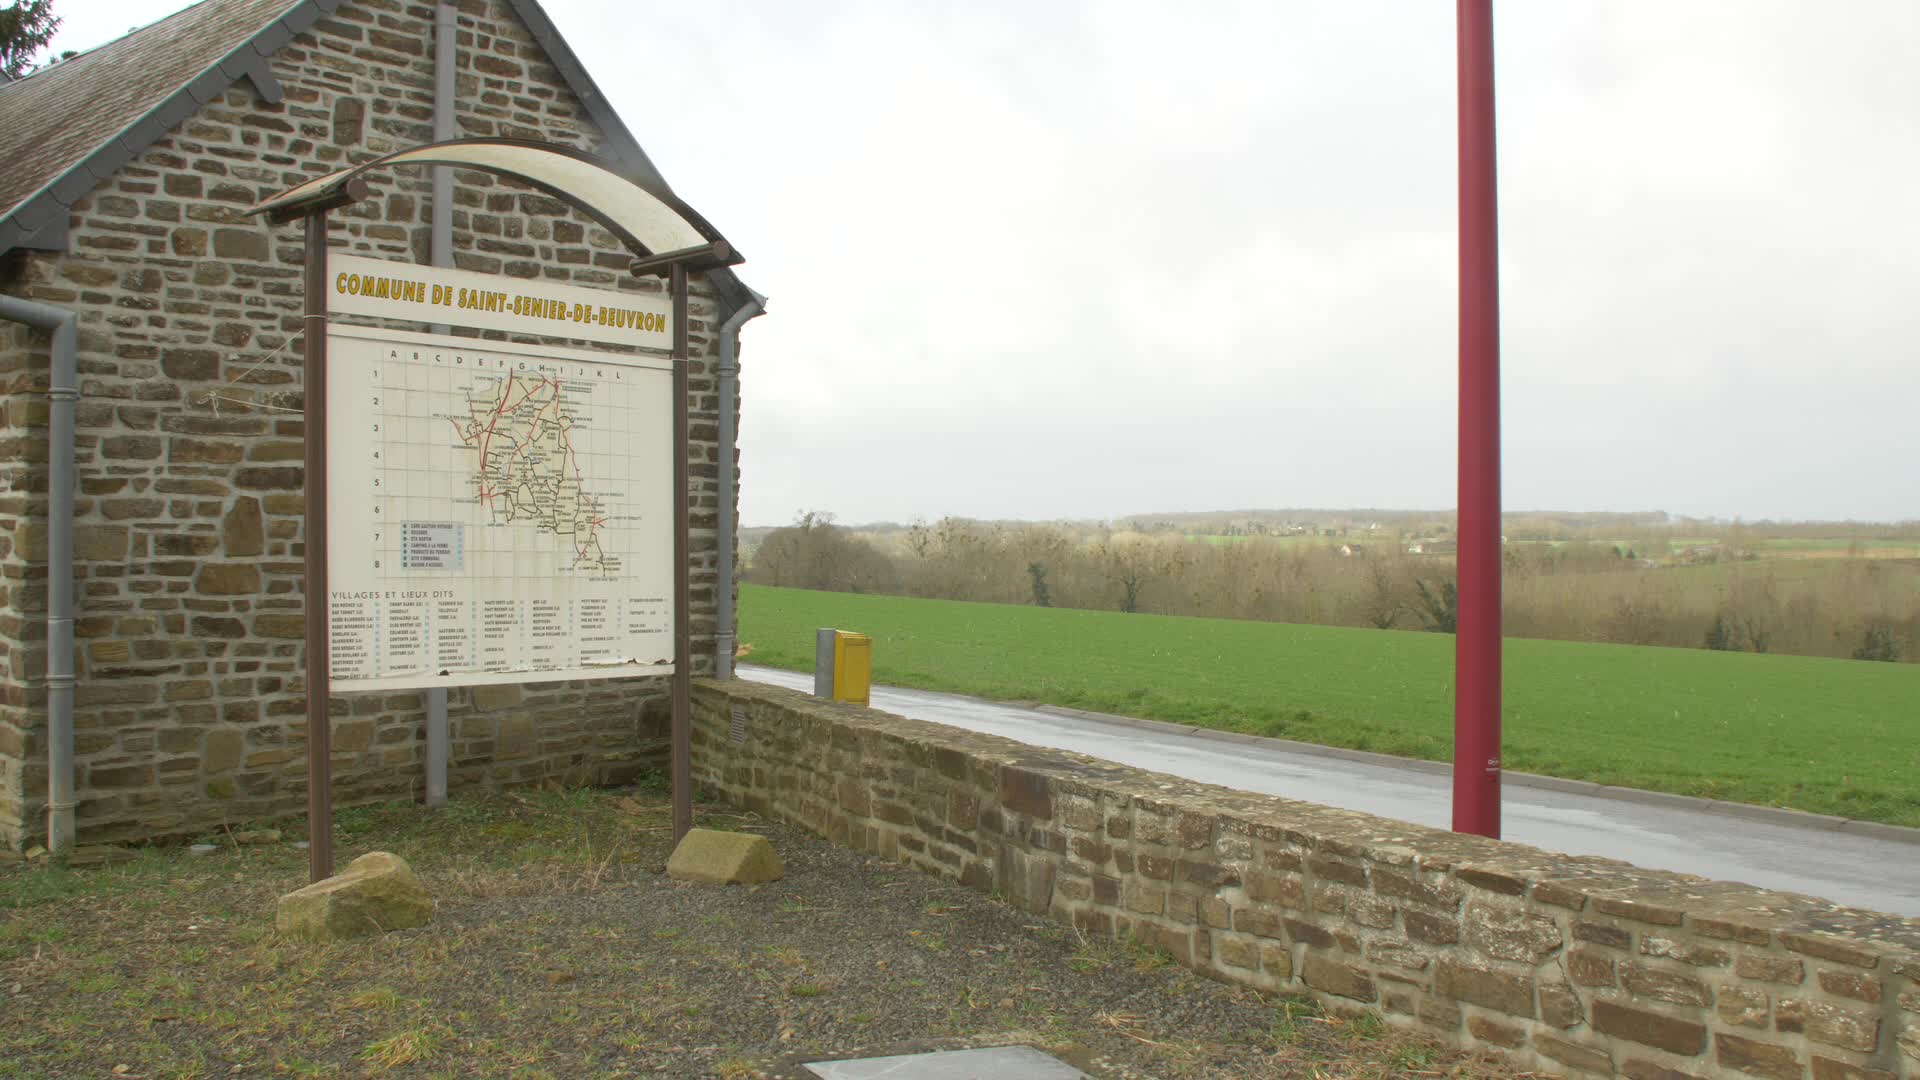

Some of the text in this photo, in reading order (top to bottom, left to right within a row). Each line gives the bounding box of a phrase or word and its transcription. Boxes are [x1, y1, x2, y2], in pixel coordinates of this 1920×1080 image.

[336, 272, 666, 333] COMMUNE DE SAINT-SENIER-DE-BEUVRON
[390, 350, 397, 358] A
[413, 352, 419, 360] B
[435, 354, 441, 363] C
[456, 356, 463, 365] D
[478, 358, 484, 367] E
[498, 360, 504, 369] F
[518, 362, 526, 370] G
[538, 364, 546, 373] H
[579, 368, 584, 377] J
[596, 370, 603, 378] K
[616, 371, 622, 380] L
[373, 369, 378, 377] 1
[373, 397, 379, 406] 2
[373, 424, 379, 432] 3
[373, 451, 380, 459] 4
[374, 478, 380, 487] 5
[374, 505, 380, 514] 6
[374, 533, 380, 541] 7
[374, 560, 380, 569] 8
[331, 590, 455, 600] VILLAGES ET LIEUX DITS
